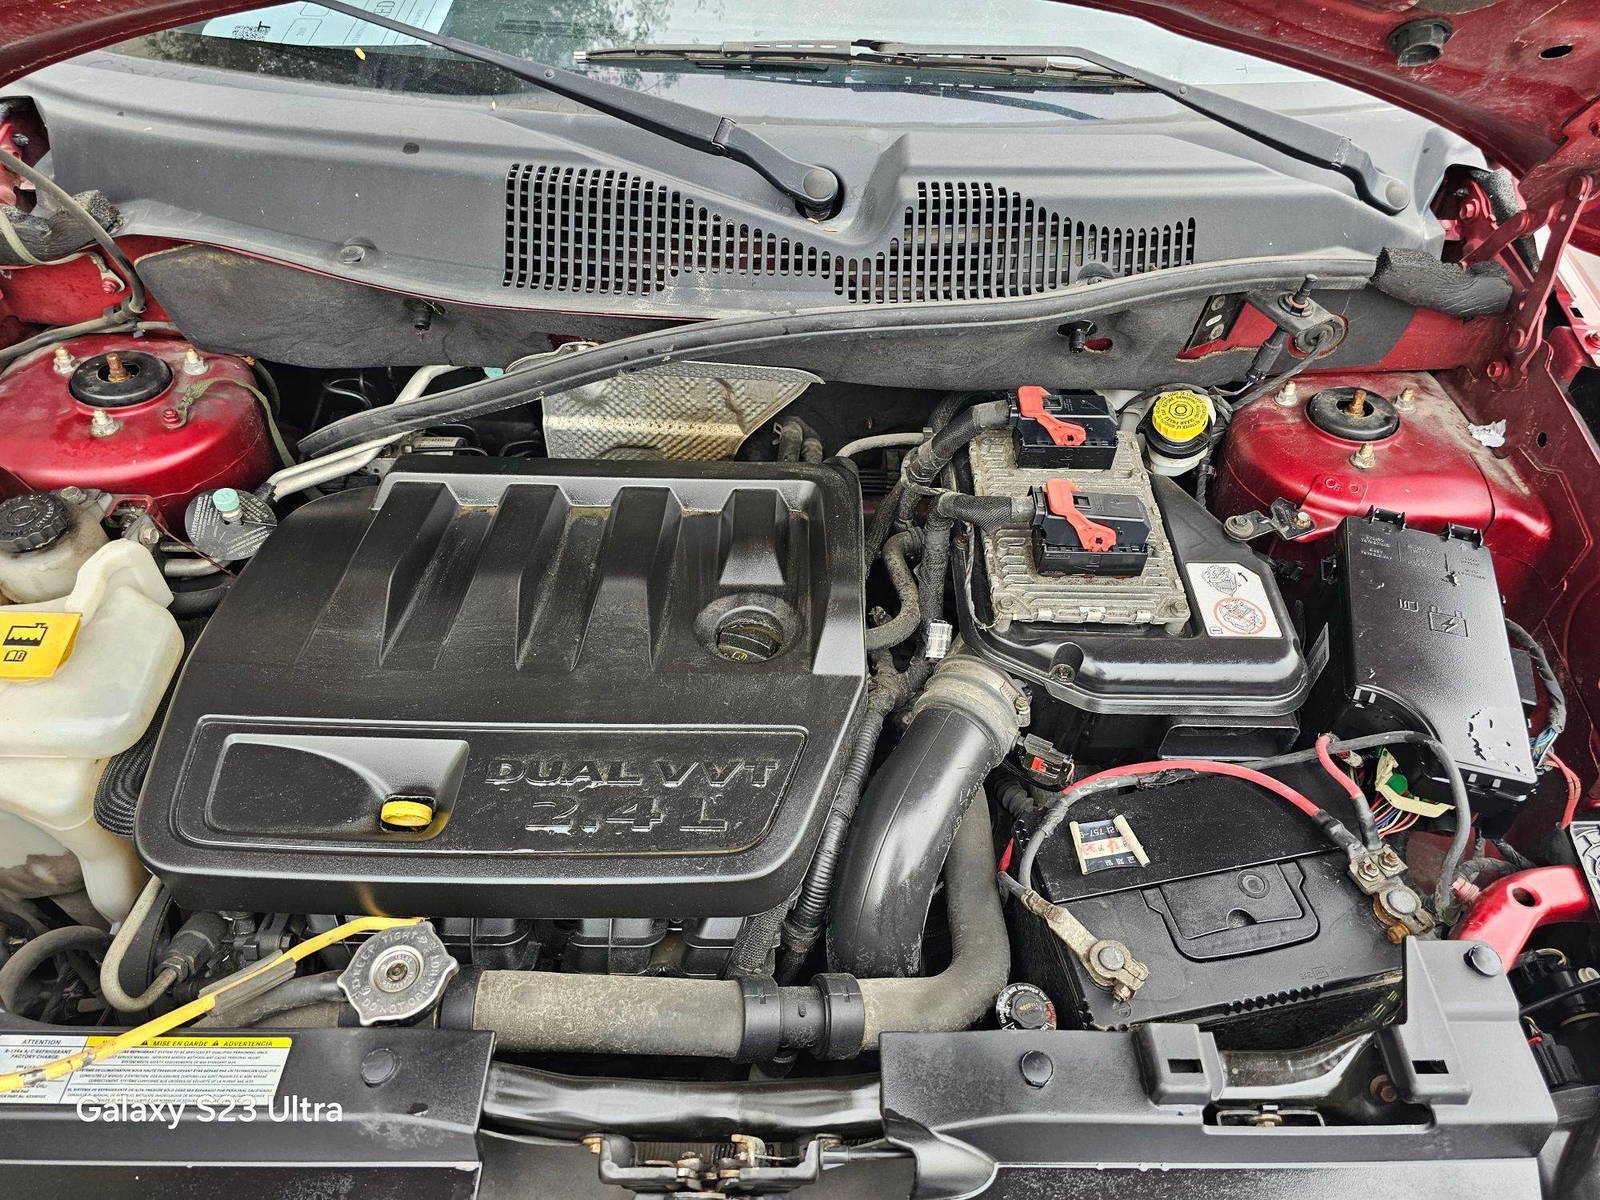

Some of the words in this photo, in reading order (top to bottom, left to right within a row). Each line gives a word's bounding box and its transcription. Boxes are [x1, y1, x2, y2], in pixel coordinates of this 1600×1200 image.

[484, 758, 643, 787] DUAL
[655, 758, 779, 787] VVT
[381, 931, 418, 944] TIGHT
